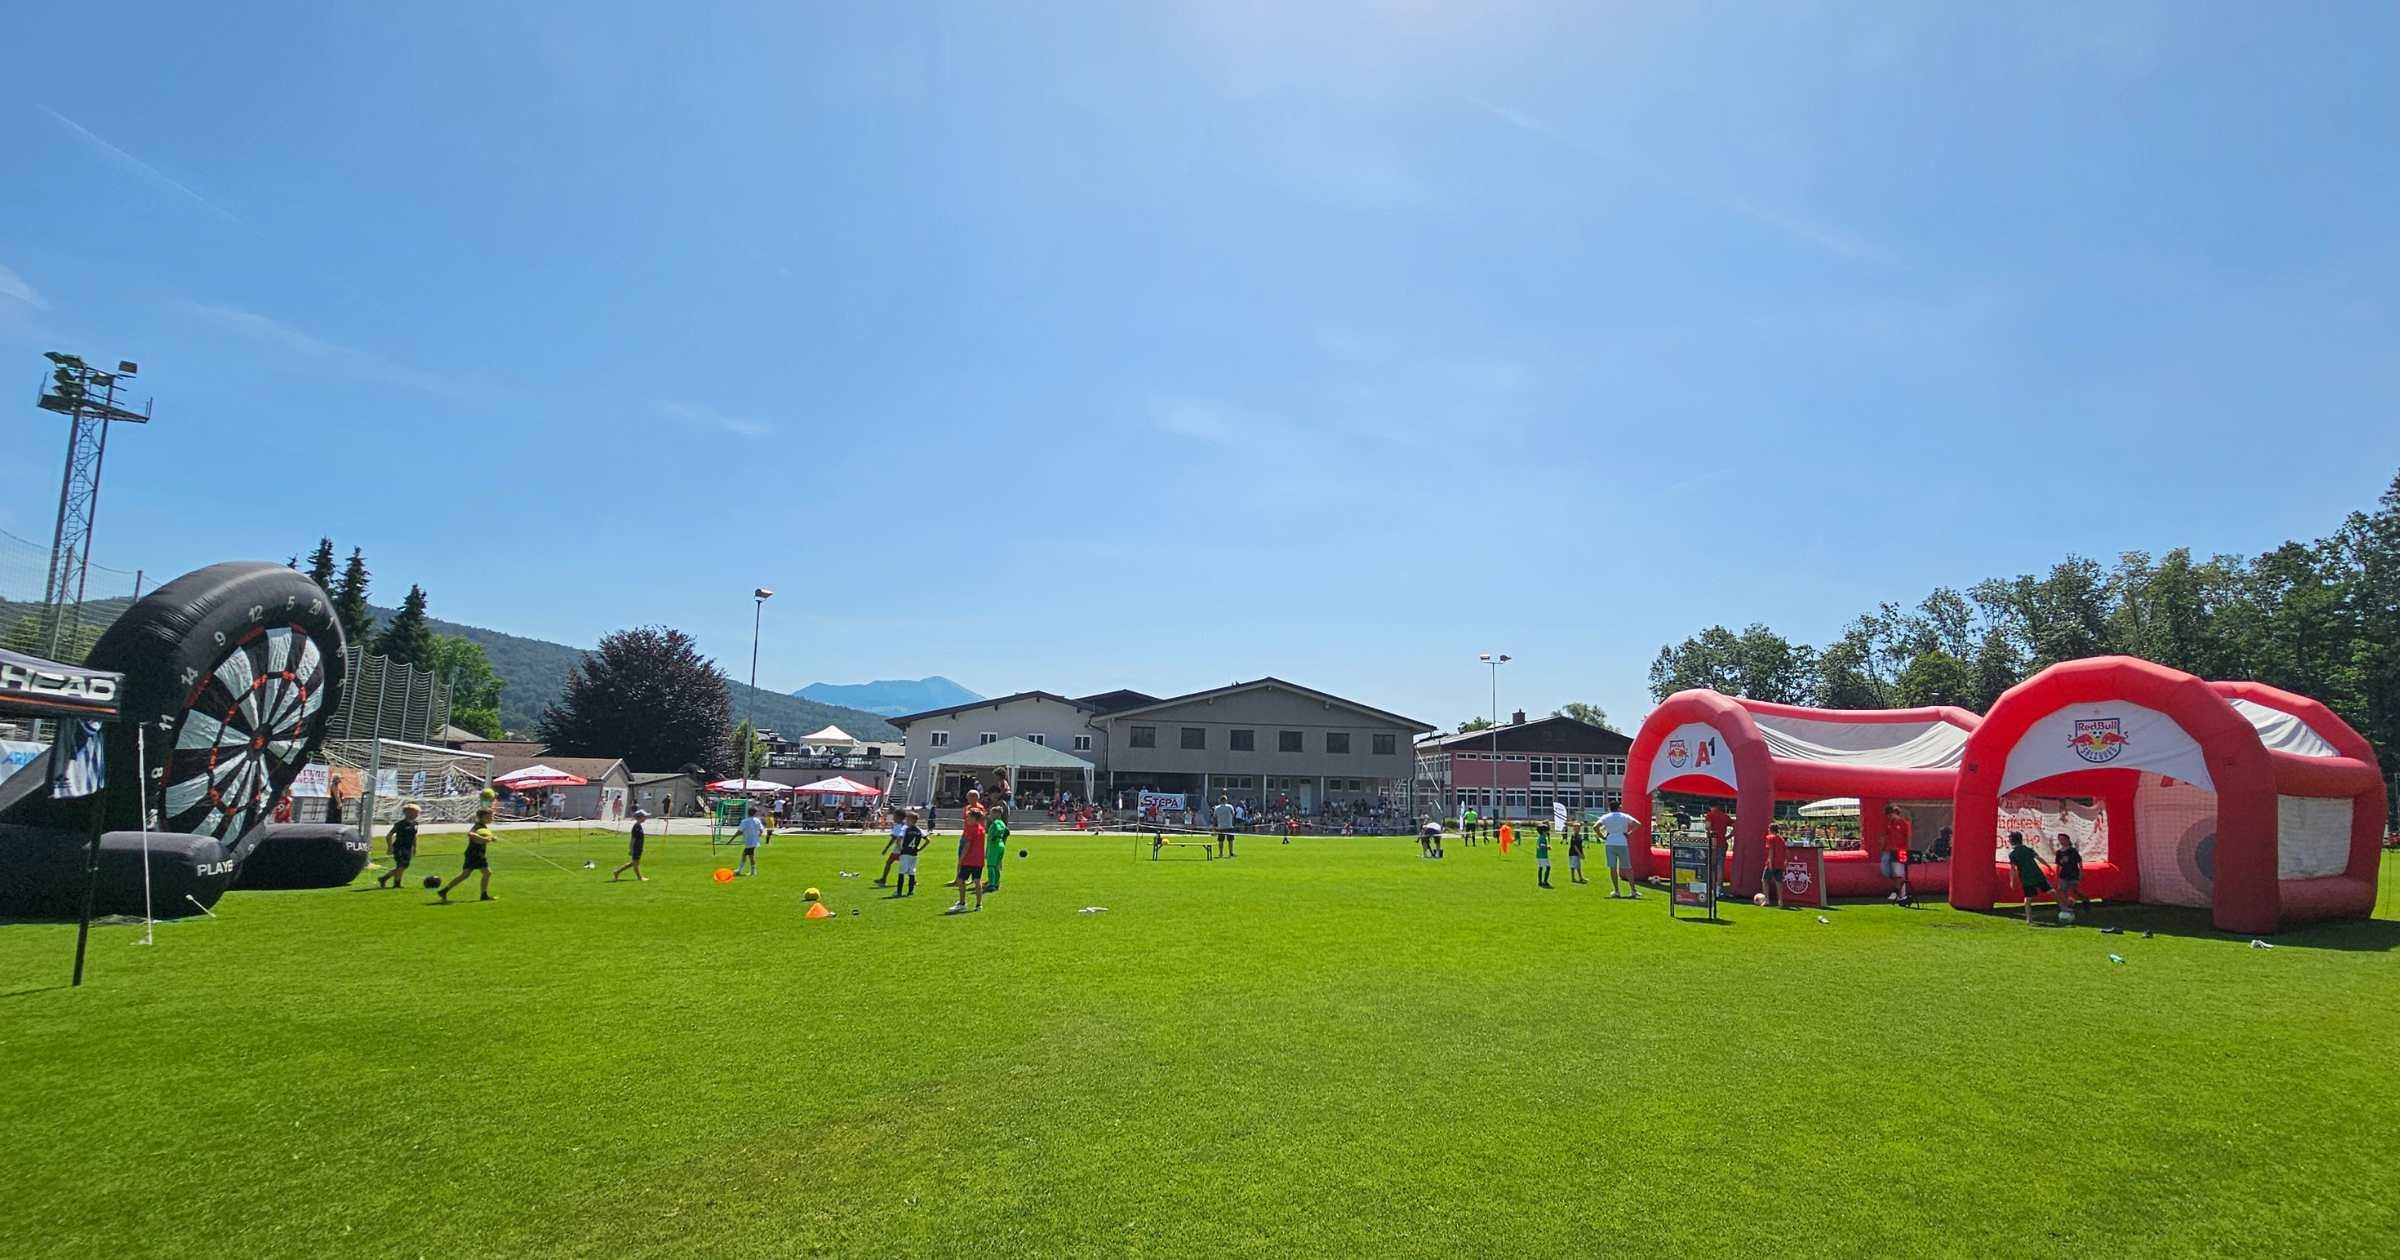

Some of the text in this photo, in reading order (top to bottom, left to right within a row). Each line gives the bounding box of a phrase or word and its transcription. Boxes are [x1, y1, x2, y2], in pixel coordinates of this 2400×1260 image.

[286, 596, 295, 611] 5
[249, 605, 264, 622] 12
[214, 631, 227, 646] 9
[0, 664, 116, 701] HEAD
[180, 666, 199, 686] 14
[159, 714, 175, 731] 11
[2098, 720, 2117, 730] Bull
[1695, 736, 1715, 768] A1
[151, 767, 164, 779] 8
[1141, 795, 1178, 808] STEPA
